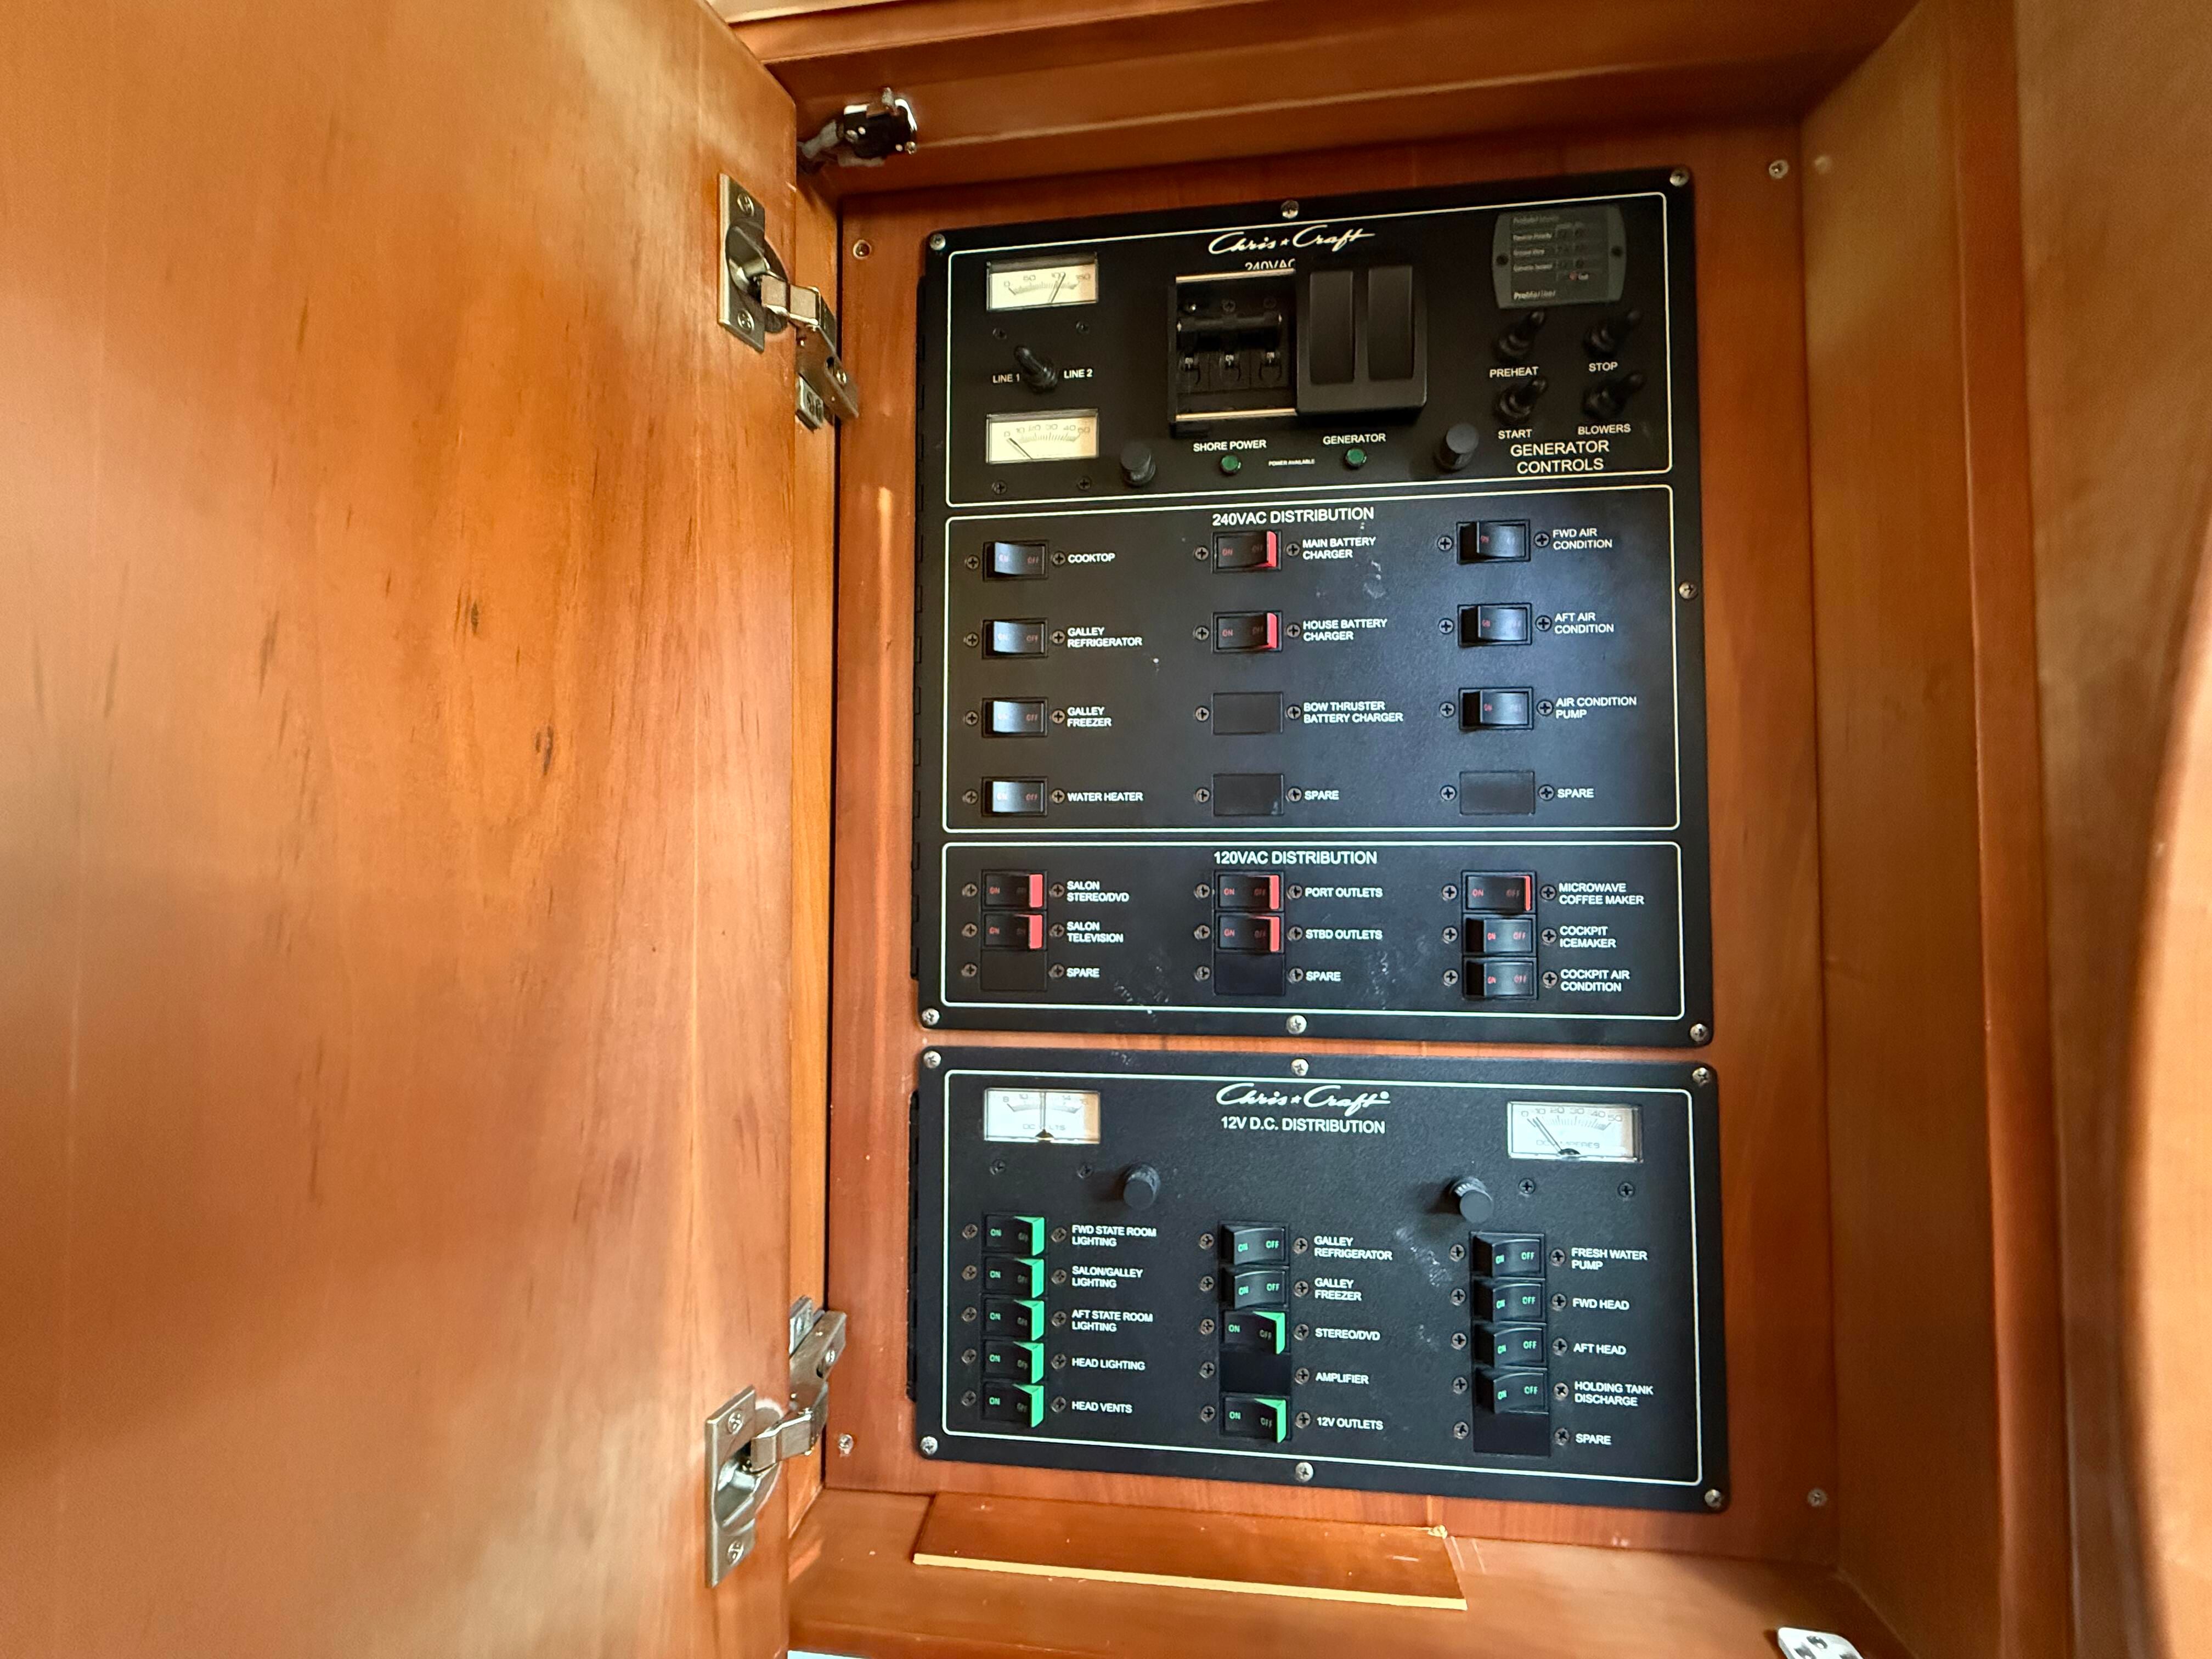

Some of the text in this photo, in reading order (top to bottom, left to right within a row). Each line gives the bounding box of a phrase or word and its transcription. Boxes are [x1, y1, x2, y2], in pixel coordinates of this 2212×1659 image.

[1209, 225, 1375, 255] Chris Craft
[1489, 366, 1539, 378] PREHEAT
[1589, 362, 1618, 372] STOP
[992, 374, 1020, 383] LINE 1
[1064, 369, 1093, 379] LINE 2
[1498, 429, 1533, 439] START
[1578, 424, 1631, 435] BLOWERS
[1323, 433, 1386, 445] GENERATOR
[1193, 439, 1267, 452] SHORE POWER
[1510, 439, 1610, 457] GENERATOR
[1517, 458, 1604, 474] CONTROLS
[1212, 507, 1374, 526] 240VAC DISTRIBUTION
[1553, 528, 1597, 538] FWD AIR
[1302, 537, 1376, 549] MAIN BATTERY
[1553, 539, 1612, 550] CONDITION
[1068, 553, 1115, 563] COOKTOP
[1302, 549, 1353, 560] CHARGER
[1555, 612, 1595, 622] AFT AIR
[1303, 619, 1387, 630] HOUSE BATTERY
[1555, 624, 1614, 634] CONDITION
[1068, 627, 1104, 636] GALLEY
[1303, 631, 1353, 641] CHARGER
[1068, 637, 1142, 648] REFRIGERATOR
[1304, 701, 1385, 712] BOW THRUSTER
[1556, 696, 1637, 707] AIR CONDITION
[1068, 707, 1104, 716] GALLEY
[1556, 709, 1587, 719] PUMP
[1068, 718, 1111, 727] FREEZER
[1304, 713, 1403, 724] BATTERY CHARGER
[1068, 792, 1143, 802] WATER HEATER
[1305, 790, 1339, 800] SPARE
[1558, 788, 1594, 798] SPARE
[1214, 851, 1377, 864] 120VAC DISTRIBUTION
[1067, 881, 1099, 890] SALON
[1559, 883, 1626, 892] MICROWAVE
[1067, 893, 1129, 902] STEREO/DVD
[1305, 888, 1383, 898] PORT OUTLETS
[1559, 895, 1644, 905] COFFEE MAKER
[1067, 922, 1099, 931] SALON
[1560, 926, 1608, 935] COCKPIT
[1067, 933, 1124, 943] TELEVISION
[1306, 930, 1383, 939] STBD OUTLETS
[1560, 938, 1616, 947] ICEMAKER
[1066, 968, 1099, 978] SPARE
[1306, 971, 1341, 981] SPARE
[1560, 969, 1630, 980] COCKPIT AIR
[1561, 982, 1622, 992] CONDITION
[1216, 1083, 1391, 1116] Chris Craft
[1221, 1116, 1385, 1133] 12V D.C. DISTRIBUTION
[1072, 1225, 1156, 1237] FWD STATE ROOM
[1072, 1237, 1117, 1246] LIGHTING
[1314, 1236, 1353, 1246] GALLEY
[1238, 1244, 1248, 1252] ON
[1314, 1248, 1392, 1260] REFRIGERATOR
[1572, 1248, 1647, 1260] FRESH WATER
[1572, 1260, 1603, 1270] PUMP
[1072, 1266, 1143, 1278] SALON/GALLEY
[1072, 1278, 1117, 1288] LIGHTING
[1314, 1278, 1354, 1289] GALLEY
[1239, 1286, 1249, 1295] ON
[1315, 1290, 1362, 1301] FREEZER
[1522, 1296, 1536, 1305] OFF
[1573, 1298, 1629, 1310] FWD HEAD
[1072, 1310, 1153, 1322] AFT STATE ROOM
[1072, 1322, 1117, 1332] LIGHTING
[1316, 1328, 1380, 1341] STEREO/DVD
[1523, 1341, 1536, 1349] OFF
[1573, 1344, 1627, 1355] AFT HEAD
[1072, 1358, 1146, 1370] HEAD LIGHTING
[1316, 1372, 1369, 1384] AMPLIFIER
[1575, 1381, 1654, 1395] HOLDING TANK
[1575, 1395, 1638, 1407] DISCHARGE
[1072, 1402, 1132, 1413] HEAD VENTS
[1317, 1417, 1383, 1430] 12V OUTLETS
[1576, 1434, 1611, 1445] SPARE
